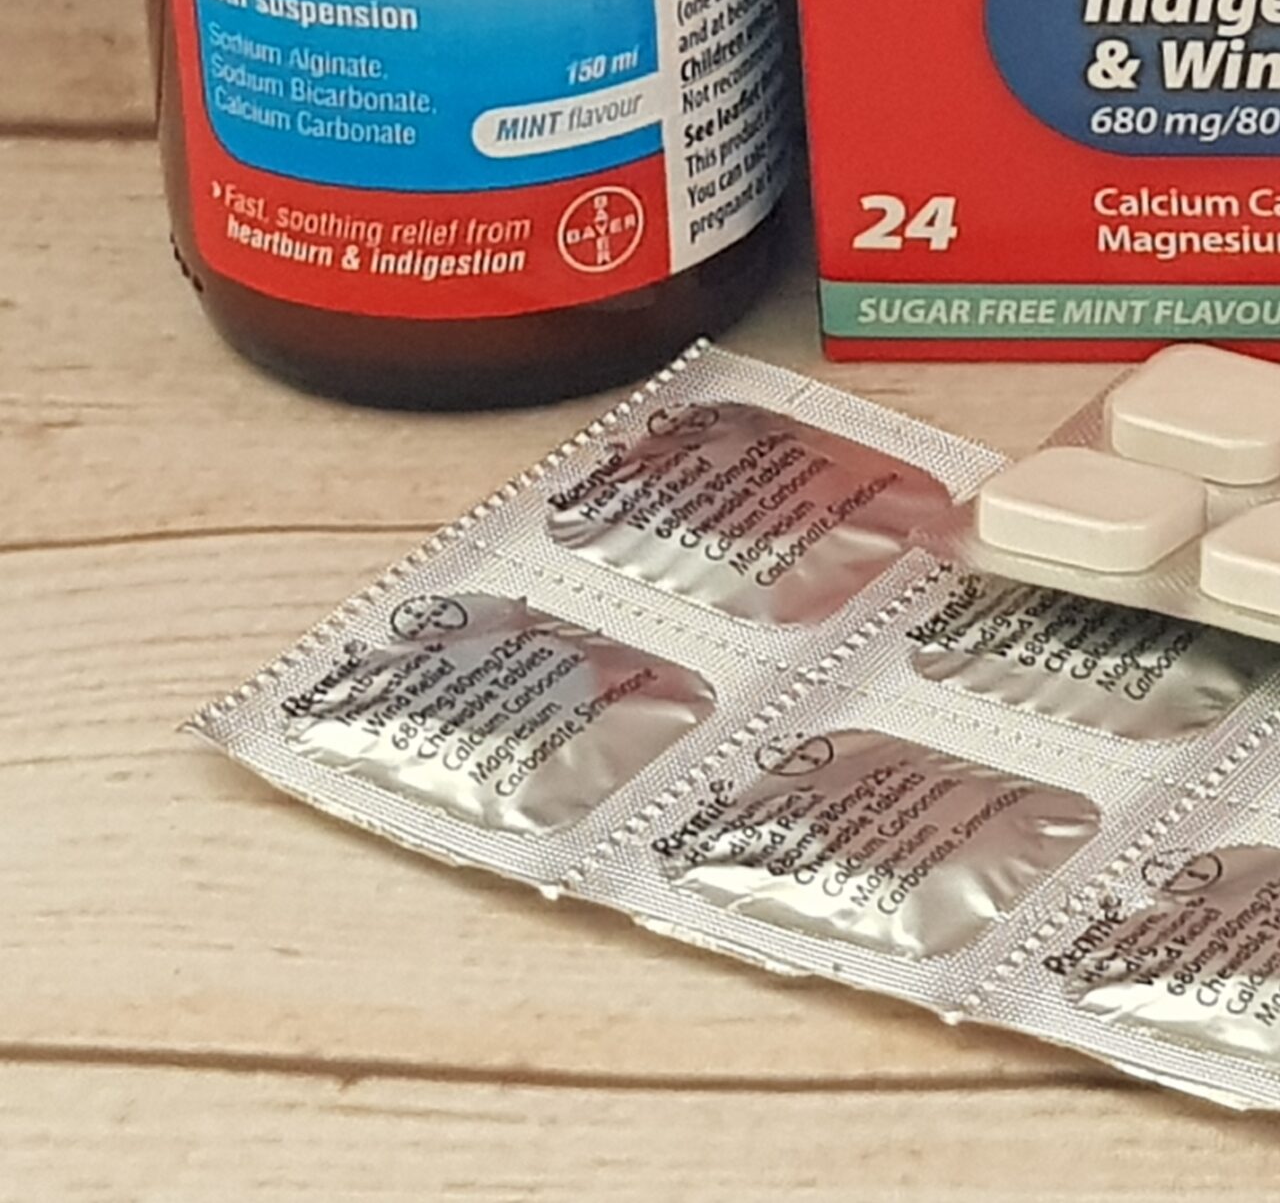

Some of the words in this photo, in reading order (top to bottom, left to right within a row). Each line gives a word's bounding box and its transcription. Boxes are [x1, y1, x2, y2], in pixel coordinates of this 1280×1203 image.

[208, 22, 281, 66] Sodium
[679, 18, 707, 53] and
[211, 53, 283, 97] Sodium
[567, 54, 606, 85] 150
[1087, 40, 1140, 91] &
[214, 86, 290, 131] Calcium
[297, 111, 416, 145] Carbonate
[682, 84, 710, 115] Not
[496, 111, 562, 142] MINT
[568, 94, 643, 131] flavour
[684, 117, 715, 148] See
[1090, 105, 1157, 135] 680
[685, 150, 717, 179] This
[687, 181, 717, 209] You
[1094, 188, 1239, 217] Calcium
[276, 206, 382, 246] soothing
[392, 217, 459, 245] relief
[467, 216, 531, 243] from
[566, 213, 636, 245] BAYER
[853, 195, 957, 251] 24
[227, 215, 332, 266] heartburn
[342, 246, 360, 270] &
[372, 249, 525, 280] indigestion
[858, 298, 970, 325] SUGAR
[978, 299, 1055, 325] FREE
[1064, 299, 1149, 325] MINT
[469, 701, 562, 785] Magnesium
